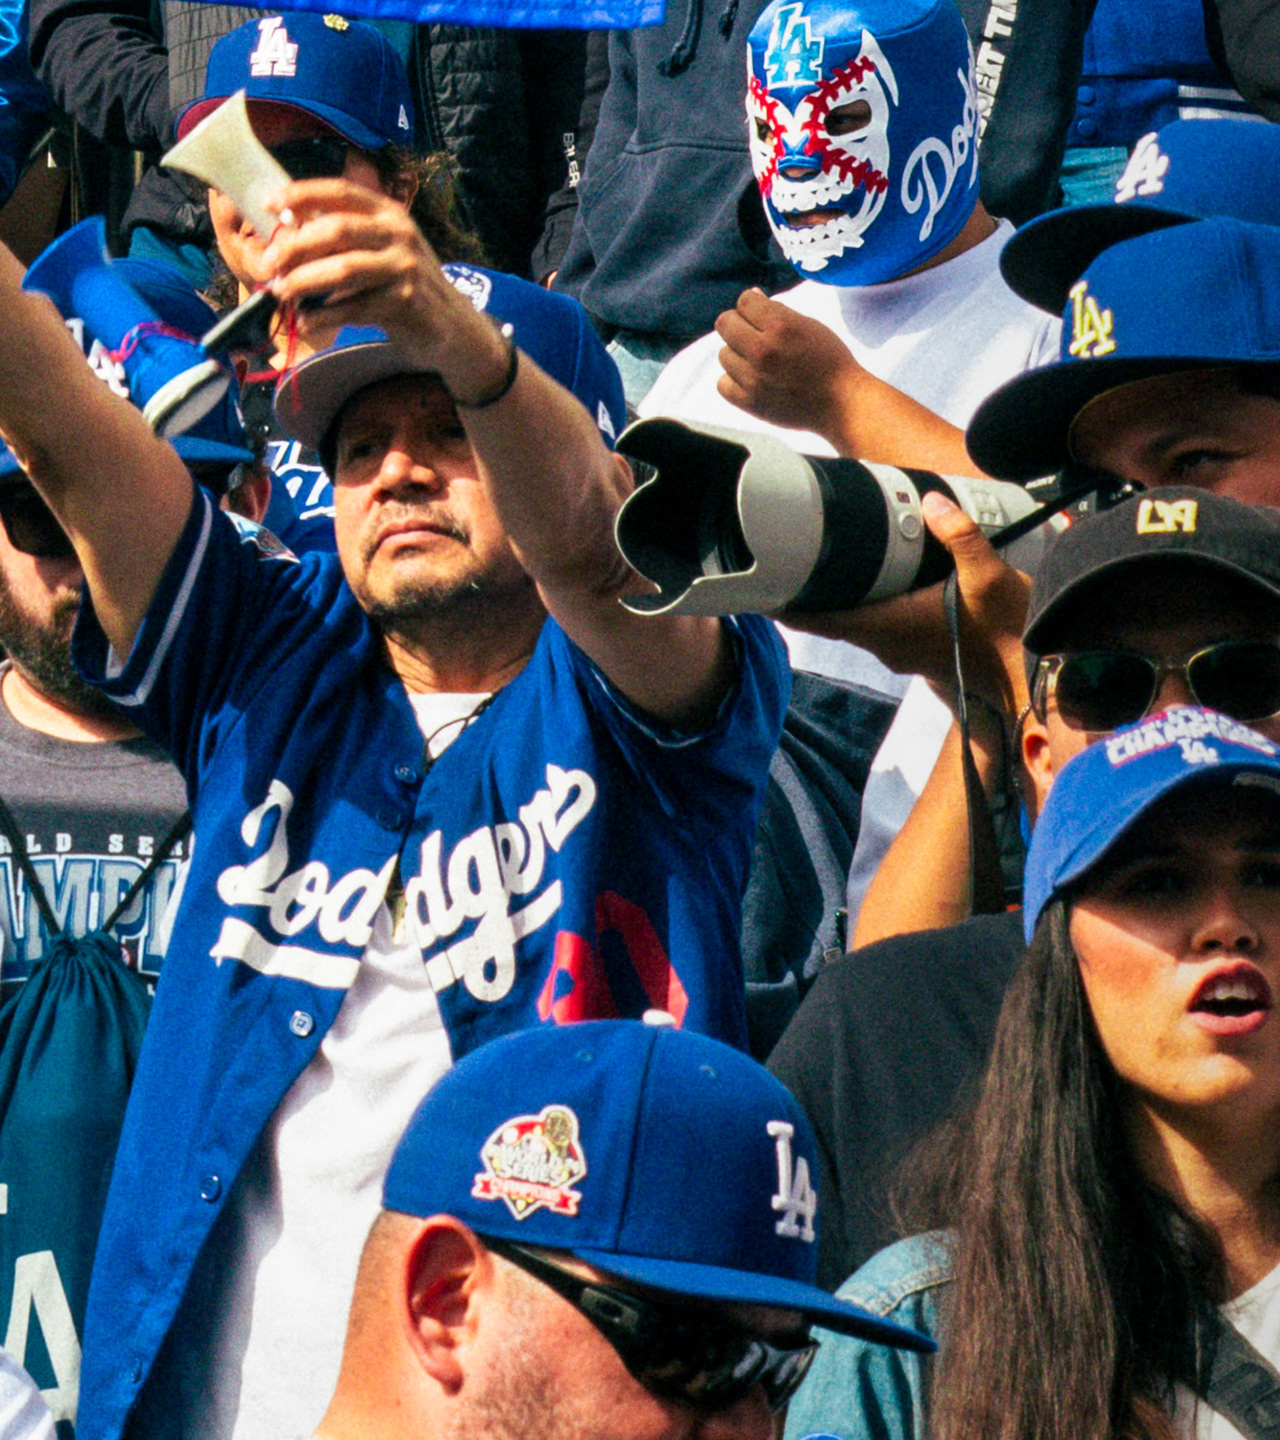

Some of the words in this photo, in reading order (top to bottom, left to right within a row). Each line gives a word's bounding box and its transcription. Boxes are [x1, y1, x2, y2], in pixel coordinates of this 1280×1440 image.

[250, 16, 298, 77] LA
[764, 1, 825, 90] LA
[1068, 280, 1117, 358] LA
[766, 1121, 817, 1243] LA
